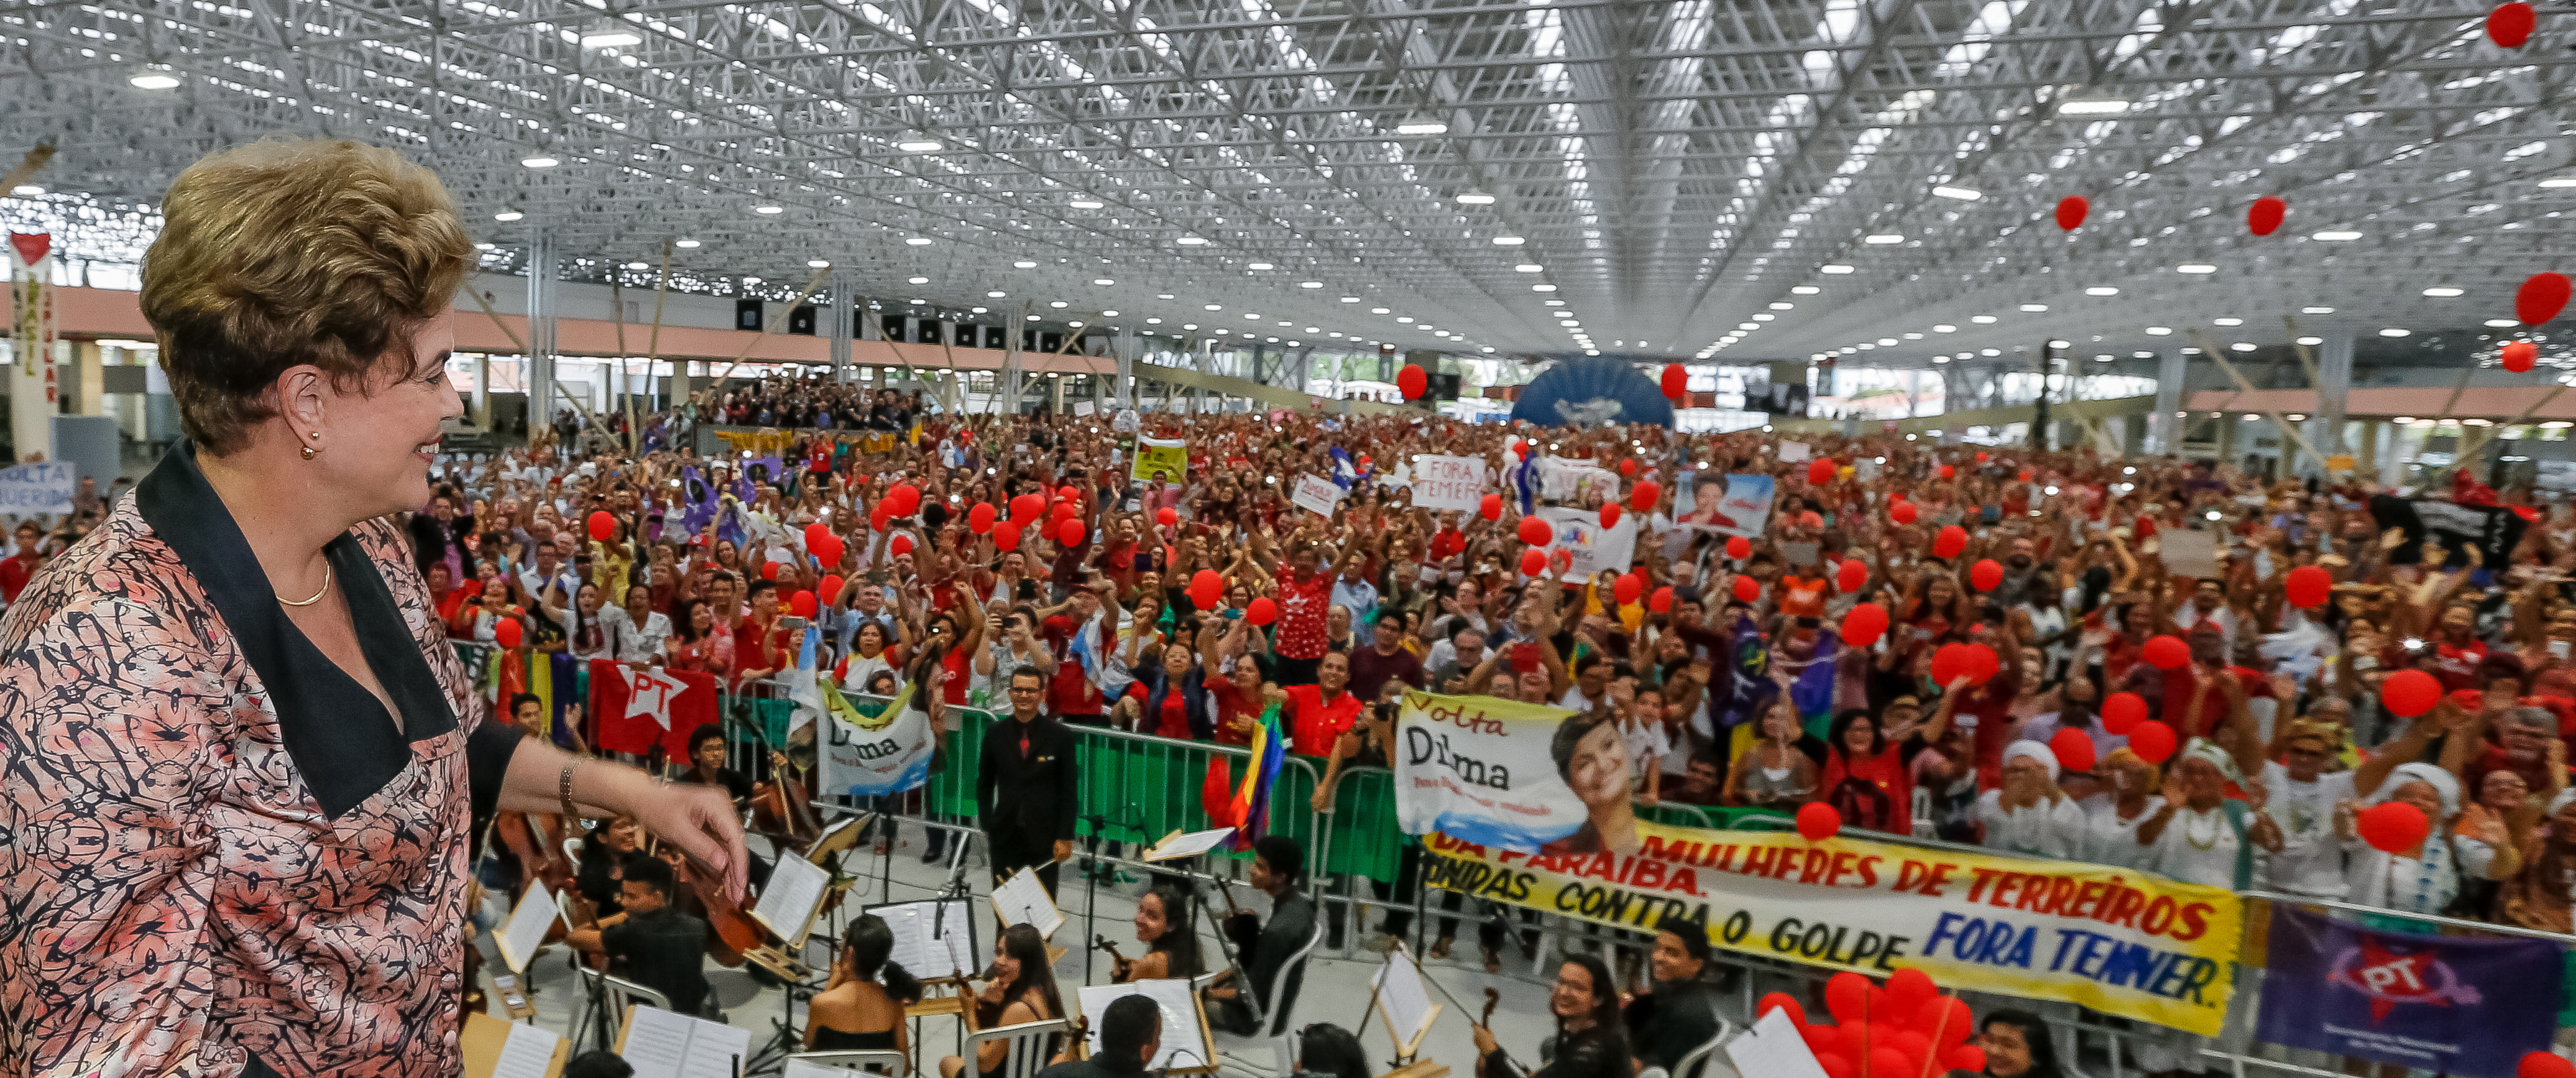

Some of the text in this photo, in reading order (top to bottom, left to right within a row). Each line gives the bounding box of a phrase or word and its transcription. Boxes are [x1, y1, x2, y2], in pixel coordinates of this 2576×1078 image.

[1431, 461, 1473, 480] FORA
[631, 672, 673, 714] PT
[1407, 692, 1509, 737] Volta
[1406, 724, 1511, 791] Dilma
[1637, 835, 1884, 888] MULHERES
[1892, 859, 1959, 897] DE
[1721, 909, 1753, 944] O
[1770, 916, 1912, 971] GOLPE
[1922, 911, 2039, 969] FORA
[2362, 957, 2417, 993] PT
